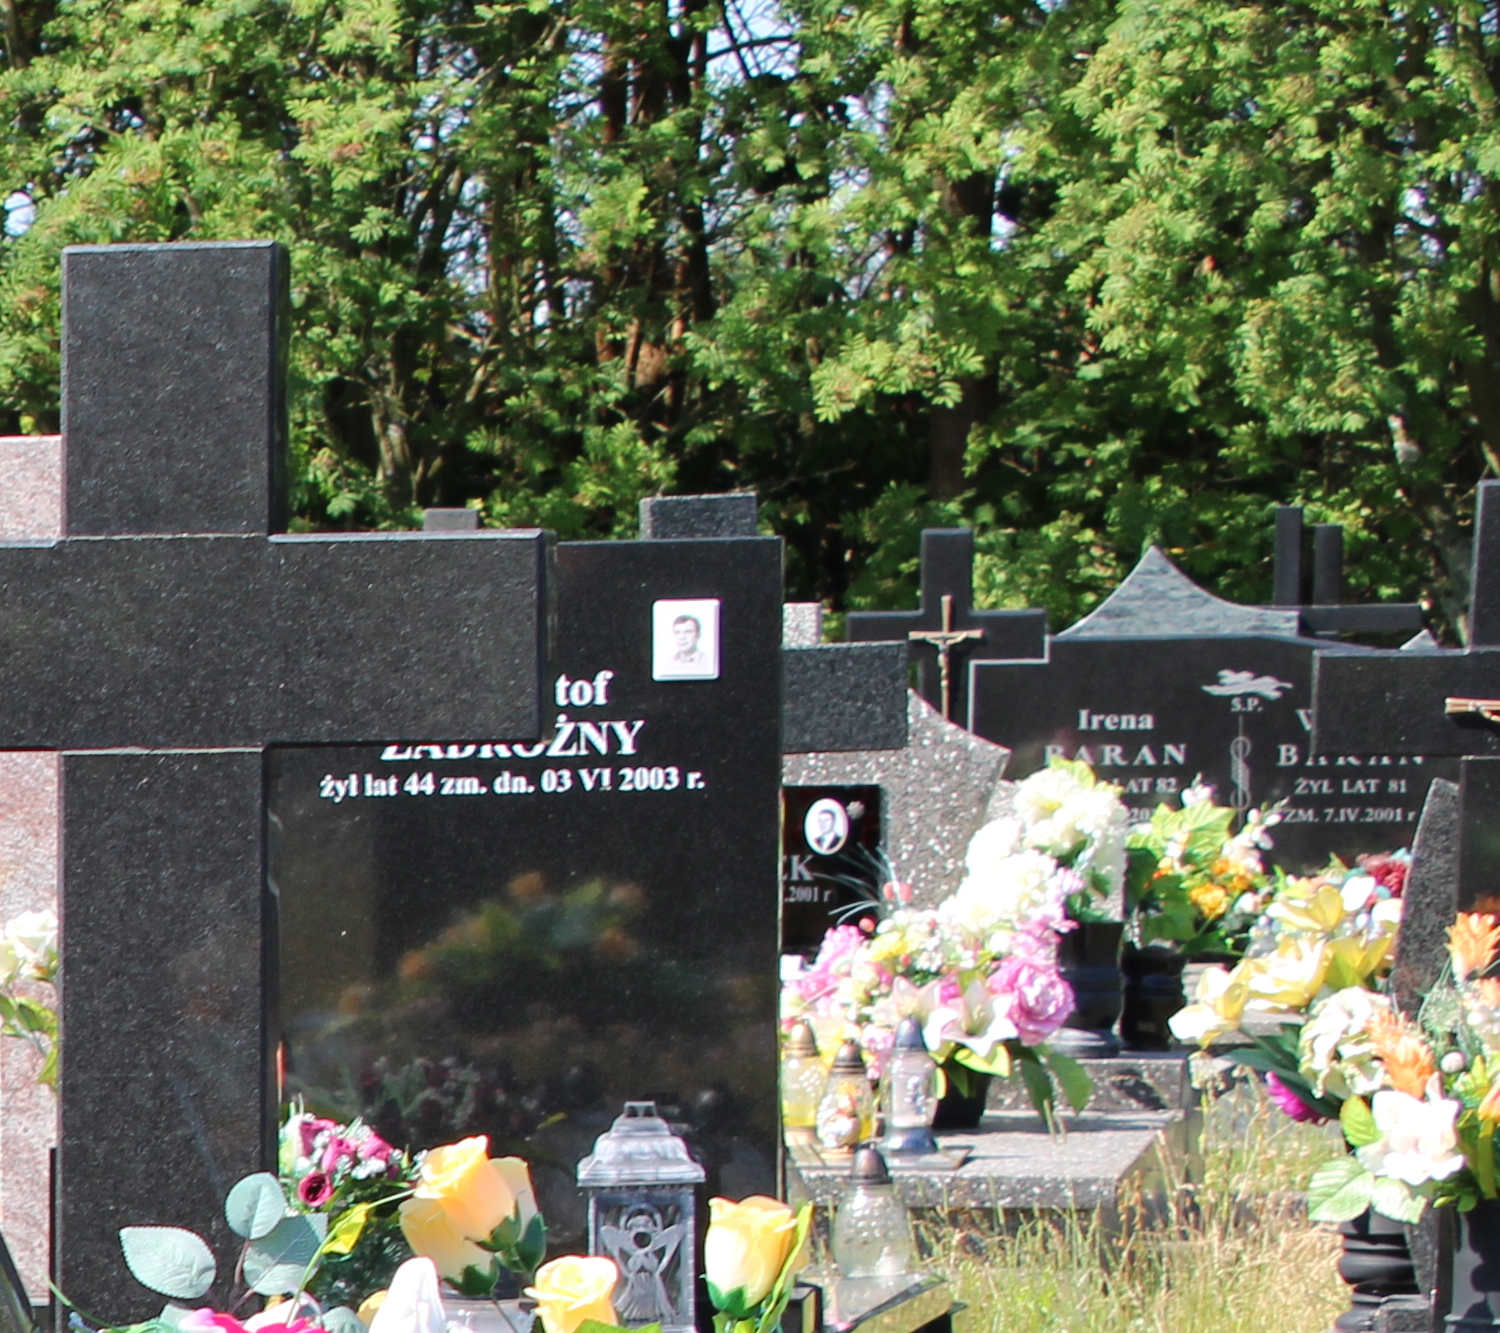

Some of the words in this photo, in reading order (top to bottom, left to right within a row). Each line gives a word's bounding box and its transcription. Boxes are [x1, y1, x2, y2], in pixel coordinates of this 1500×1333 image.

[554, 670, 614, 706] tof
[1077, 708, 1155, 731] Irena
[363, 773, 399, 796] lat
[403, 772, 436, 796] 44
[440, 775, 488, 796] zm.
[493, 770, 535, 795] dn.
[540, 768, 573, 794] 03
[618, 766, 680, 792] 2003
[686, 770, 706, 790] r.
[1112, 777, 1154, 793] AT
[1155, 777, 1178, 793] 82
[1342, 778, 1381, 793] LAT
[1387, 778, 1408, 793] 81
[1283, 808, 1320, 822] ZM.
[1323, 808, 1403, 822] 7.IV.2001
[1408, 810, 1417, 822] r
